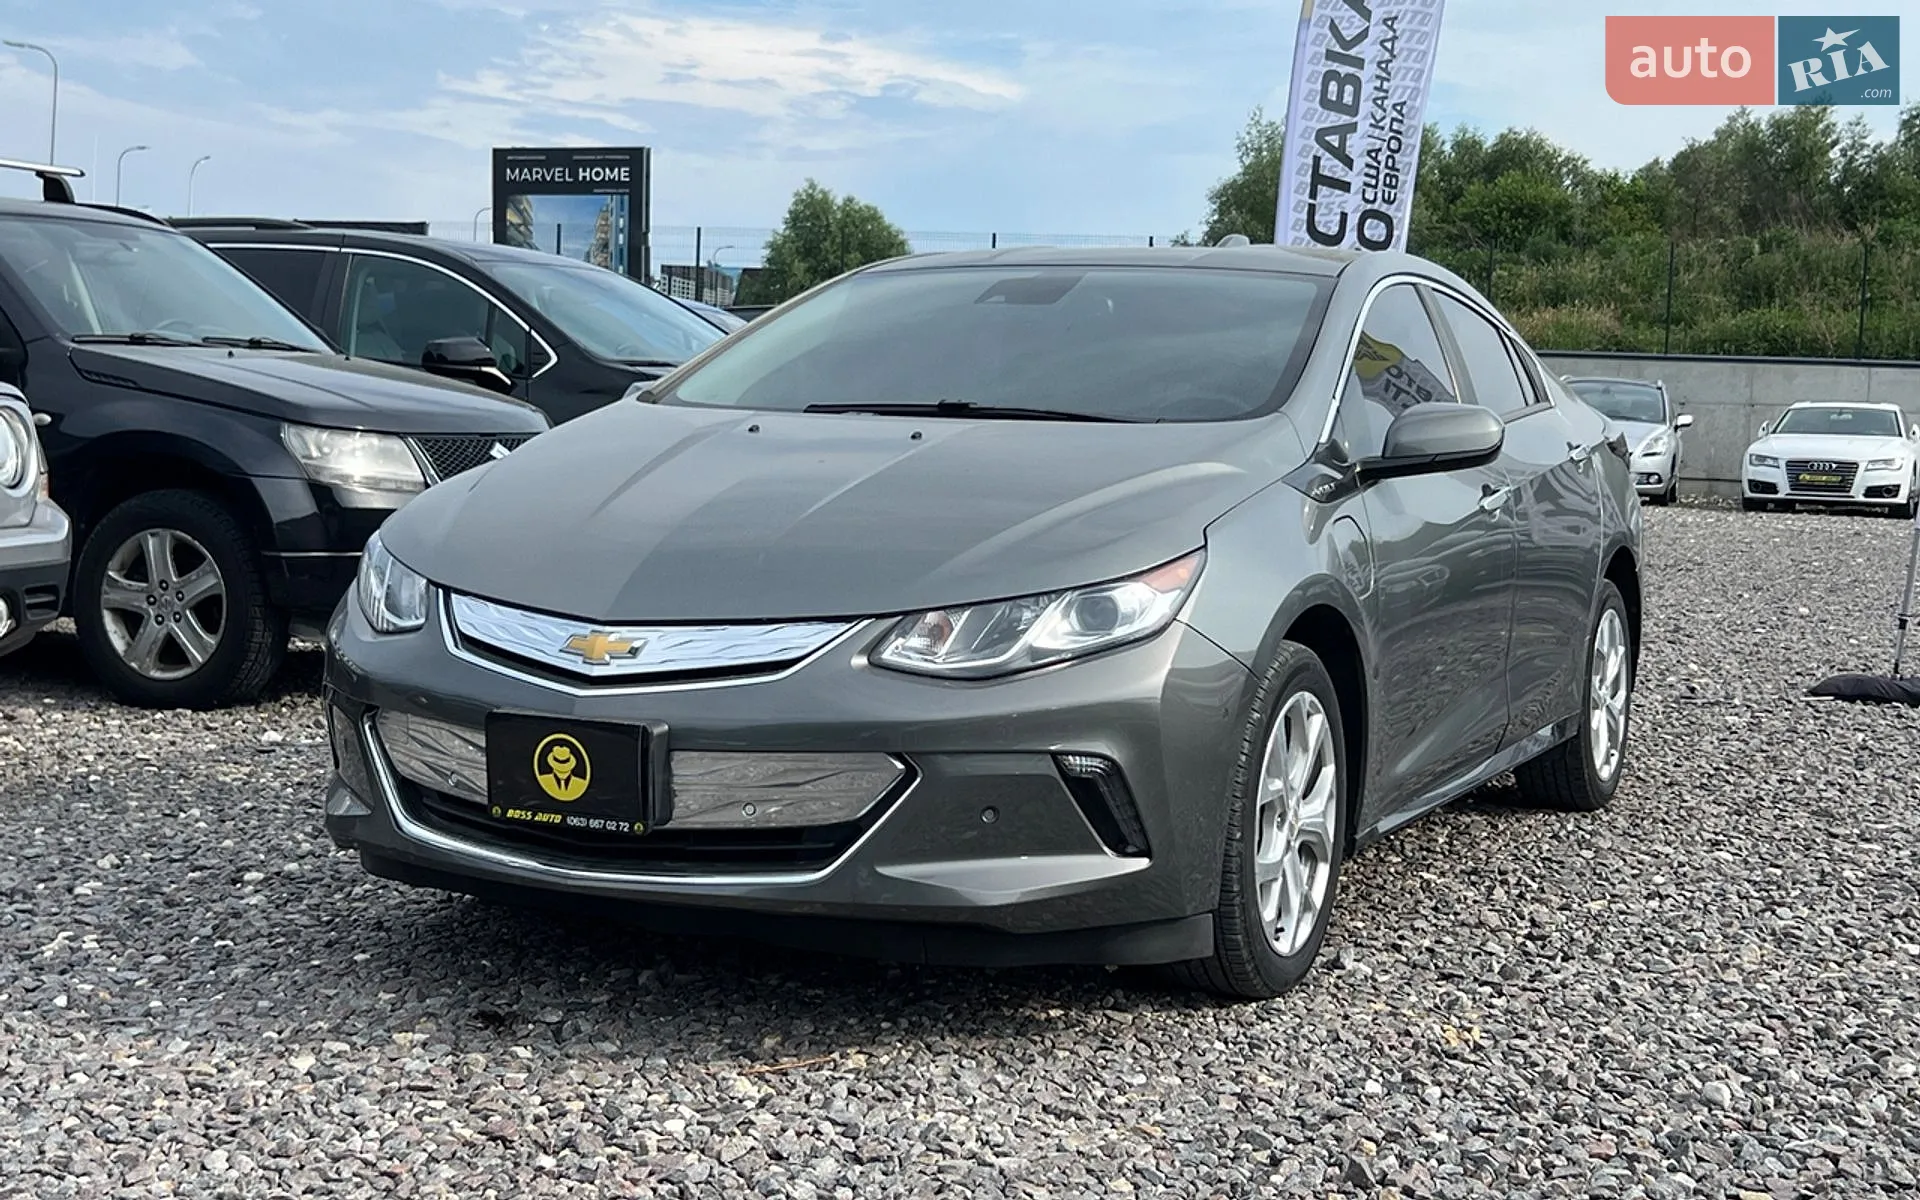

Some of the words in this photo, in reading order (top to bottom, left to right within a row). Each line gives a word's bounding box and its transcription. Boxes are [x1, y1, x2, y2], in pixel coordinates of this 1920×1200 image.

[1369, 15, 1399, 131] КАНАДА
[505, 167, 574, 182] MARVEL
[578, 167, 631, 182] HOME
[1361, 148, 1383, 205] США
[506, 808, 533, 821] BOSS
[534, 812, 563, 824] AUTO
[605, 820, 618, 831] 02
[618, 822, 631, 832] 72
